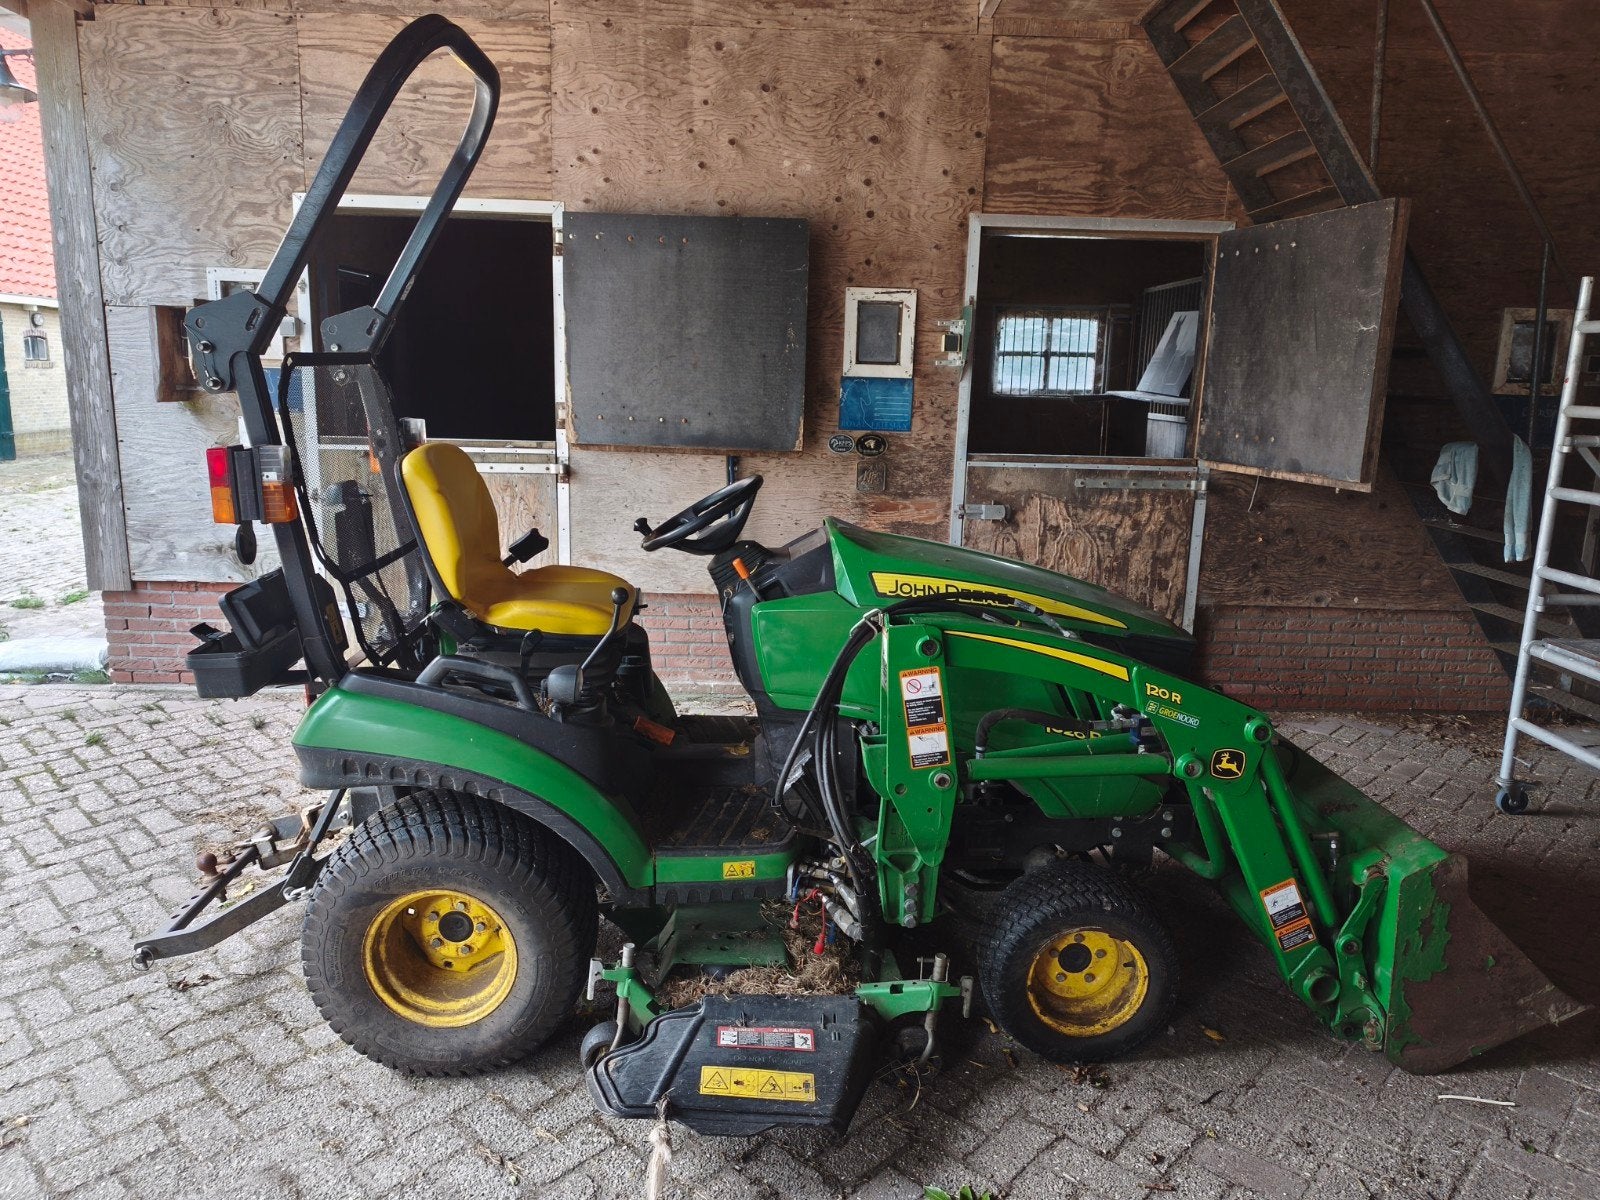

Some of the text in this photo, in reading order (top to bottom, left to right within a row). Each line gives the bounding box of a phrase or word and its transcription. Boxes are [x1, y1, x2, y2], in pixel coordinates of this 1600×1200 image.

[888, 579, 940, 597] JOHN
[907, 667, 938, 676] WARNING
[1145, 682, 1182, 705] 120 R
[1159, 707, 1199, 726] GROENOORD
[915, 725, 945, 734] WARNING
